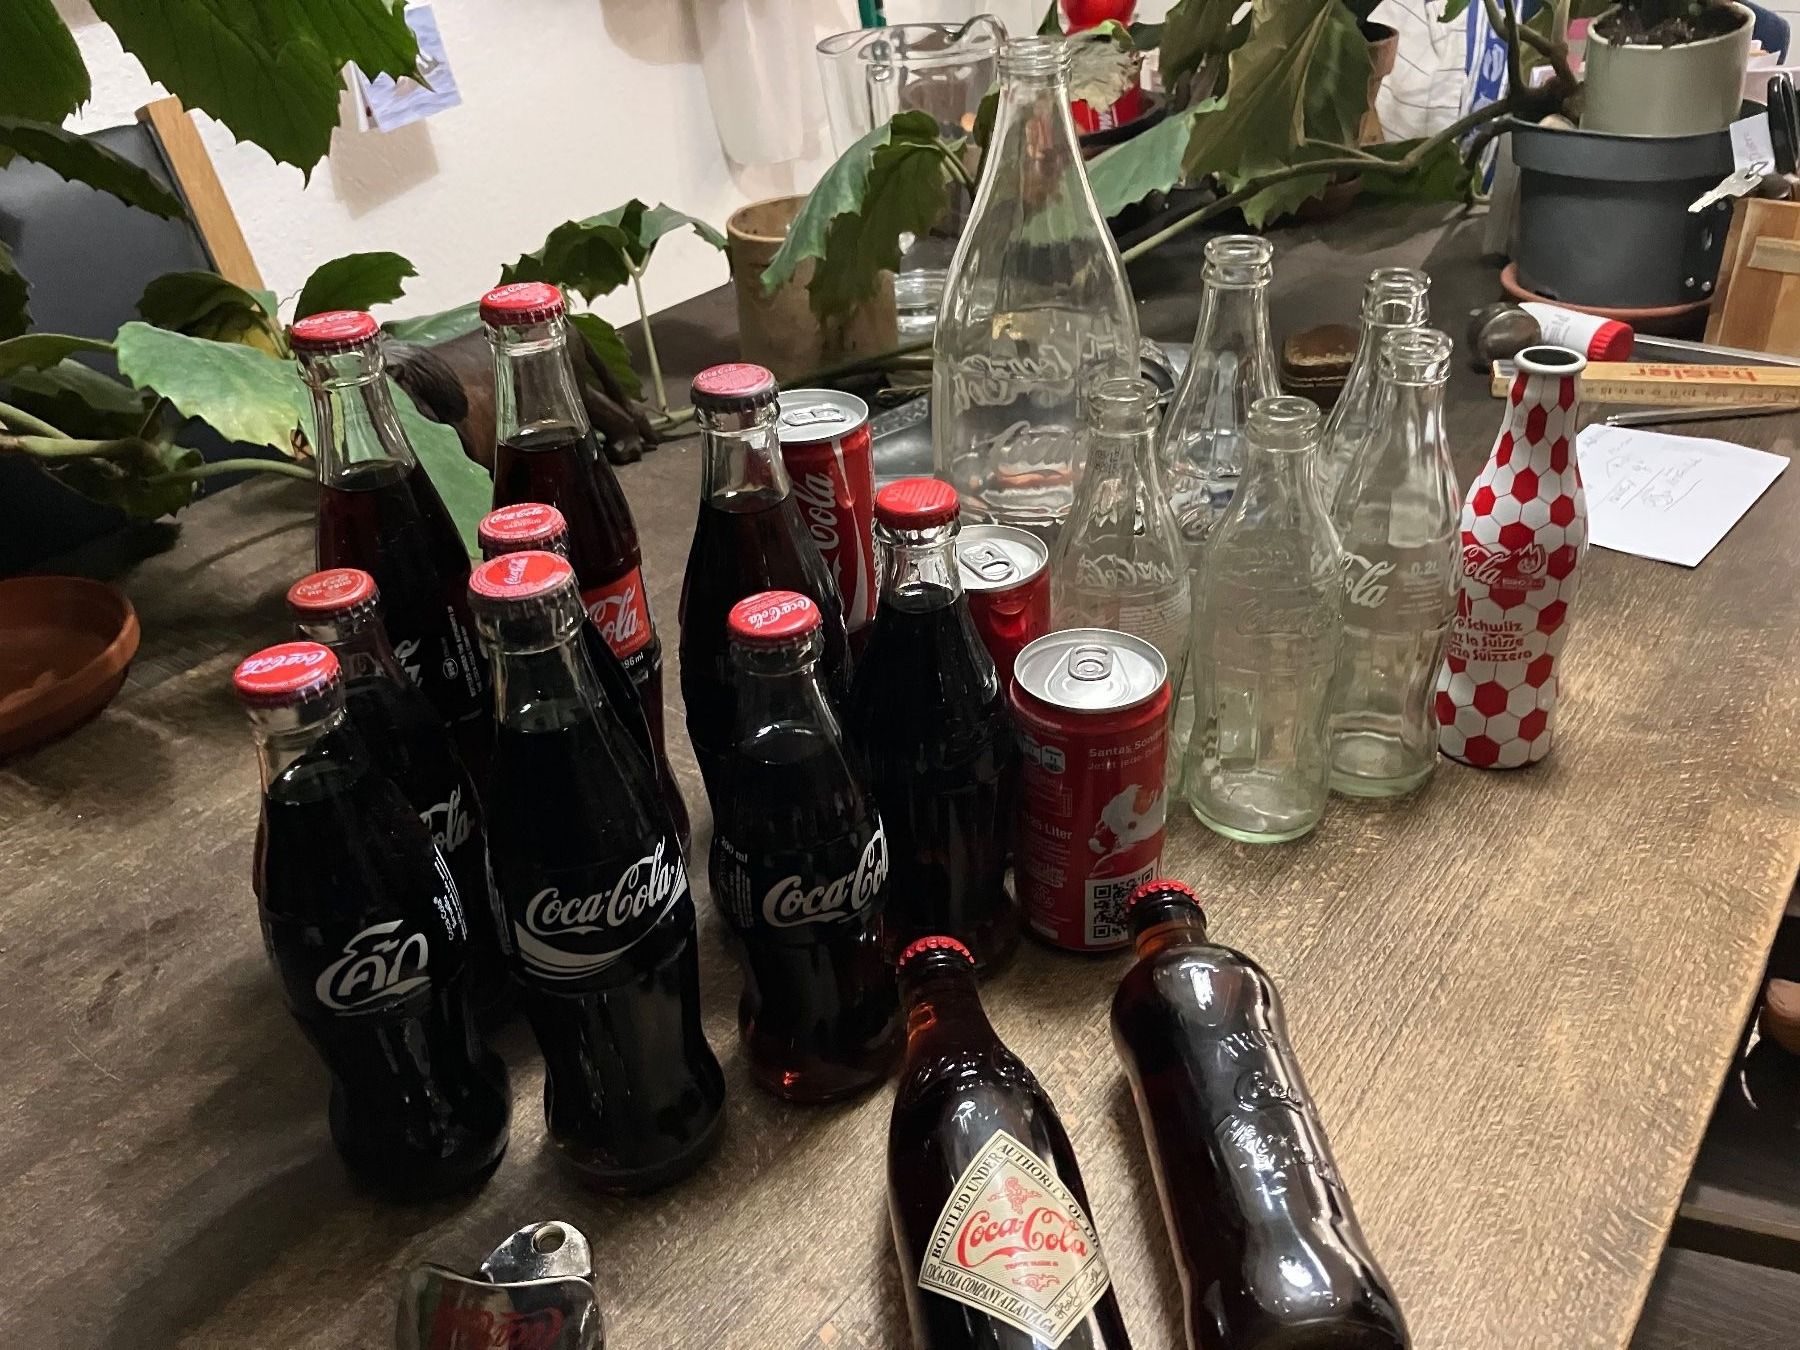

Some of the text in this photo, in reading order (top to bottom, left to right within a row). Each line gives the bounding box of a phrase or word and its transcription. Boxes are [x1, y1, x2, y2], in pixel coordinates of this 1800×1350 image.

[1045, 823, 1073, 840] Liter
[525, 834, 673, 937] Coca-Cola
[931, 1194, 971, 1260] BOTTLED
[971, 1151, 1004, 1193] UNDER
[957, 1206, 1088, 1269] Coca-Cola
[926, 1263, 961, 1288] COCA-COLA
[960, 1274, 1003, 1304] COMPANY
